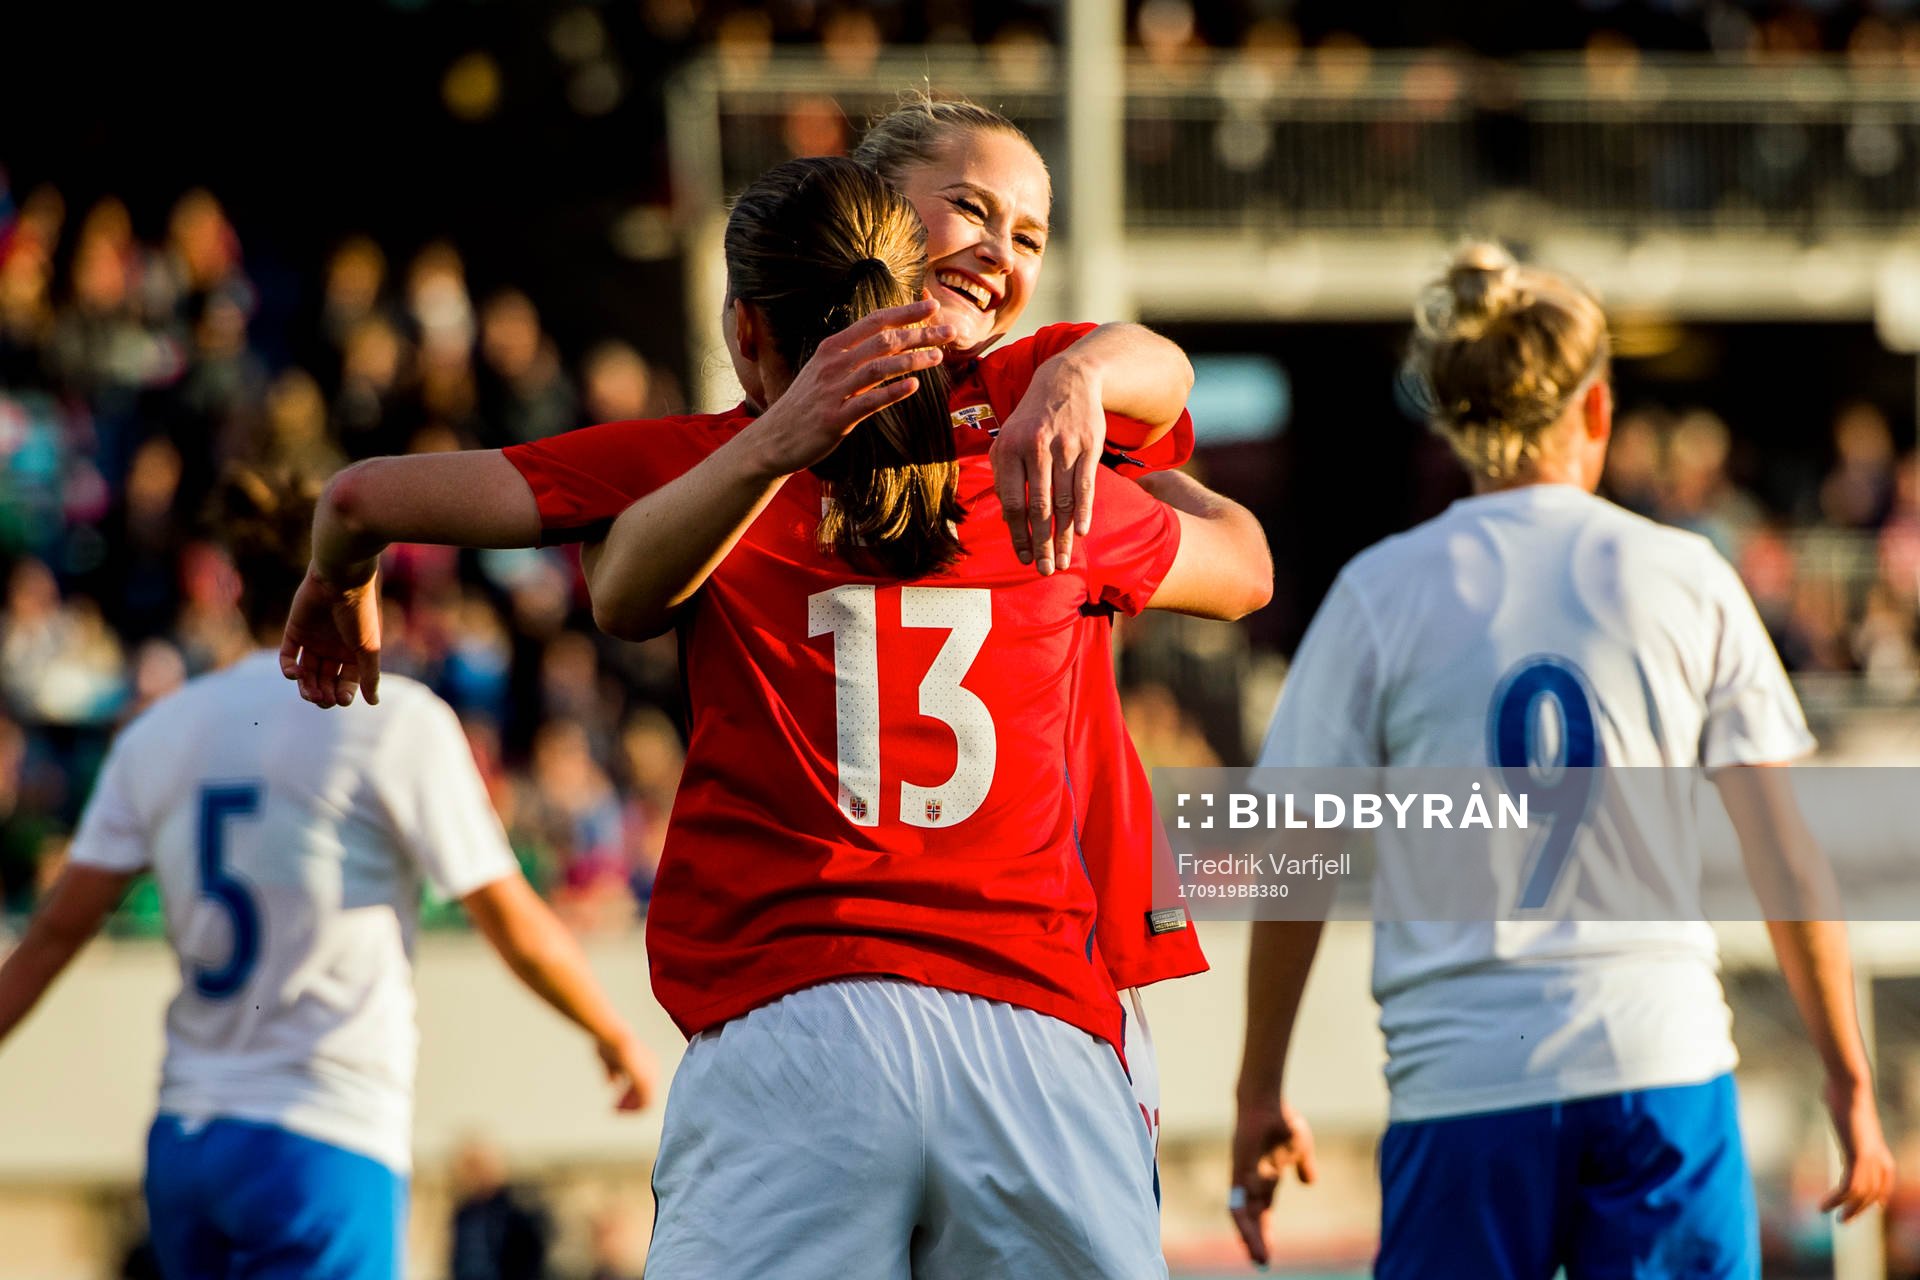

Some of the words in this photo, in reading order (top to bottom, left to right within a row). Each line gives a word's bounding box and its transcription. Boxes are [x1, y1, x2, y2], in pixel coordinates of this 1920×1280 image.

[808, 584, 997, 828] 13
[1493, 660, 1598, 910] 9
[196, 783, 262, 999] 5
